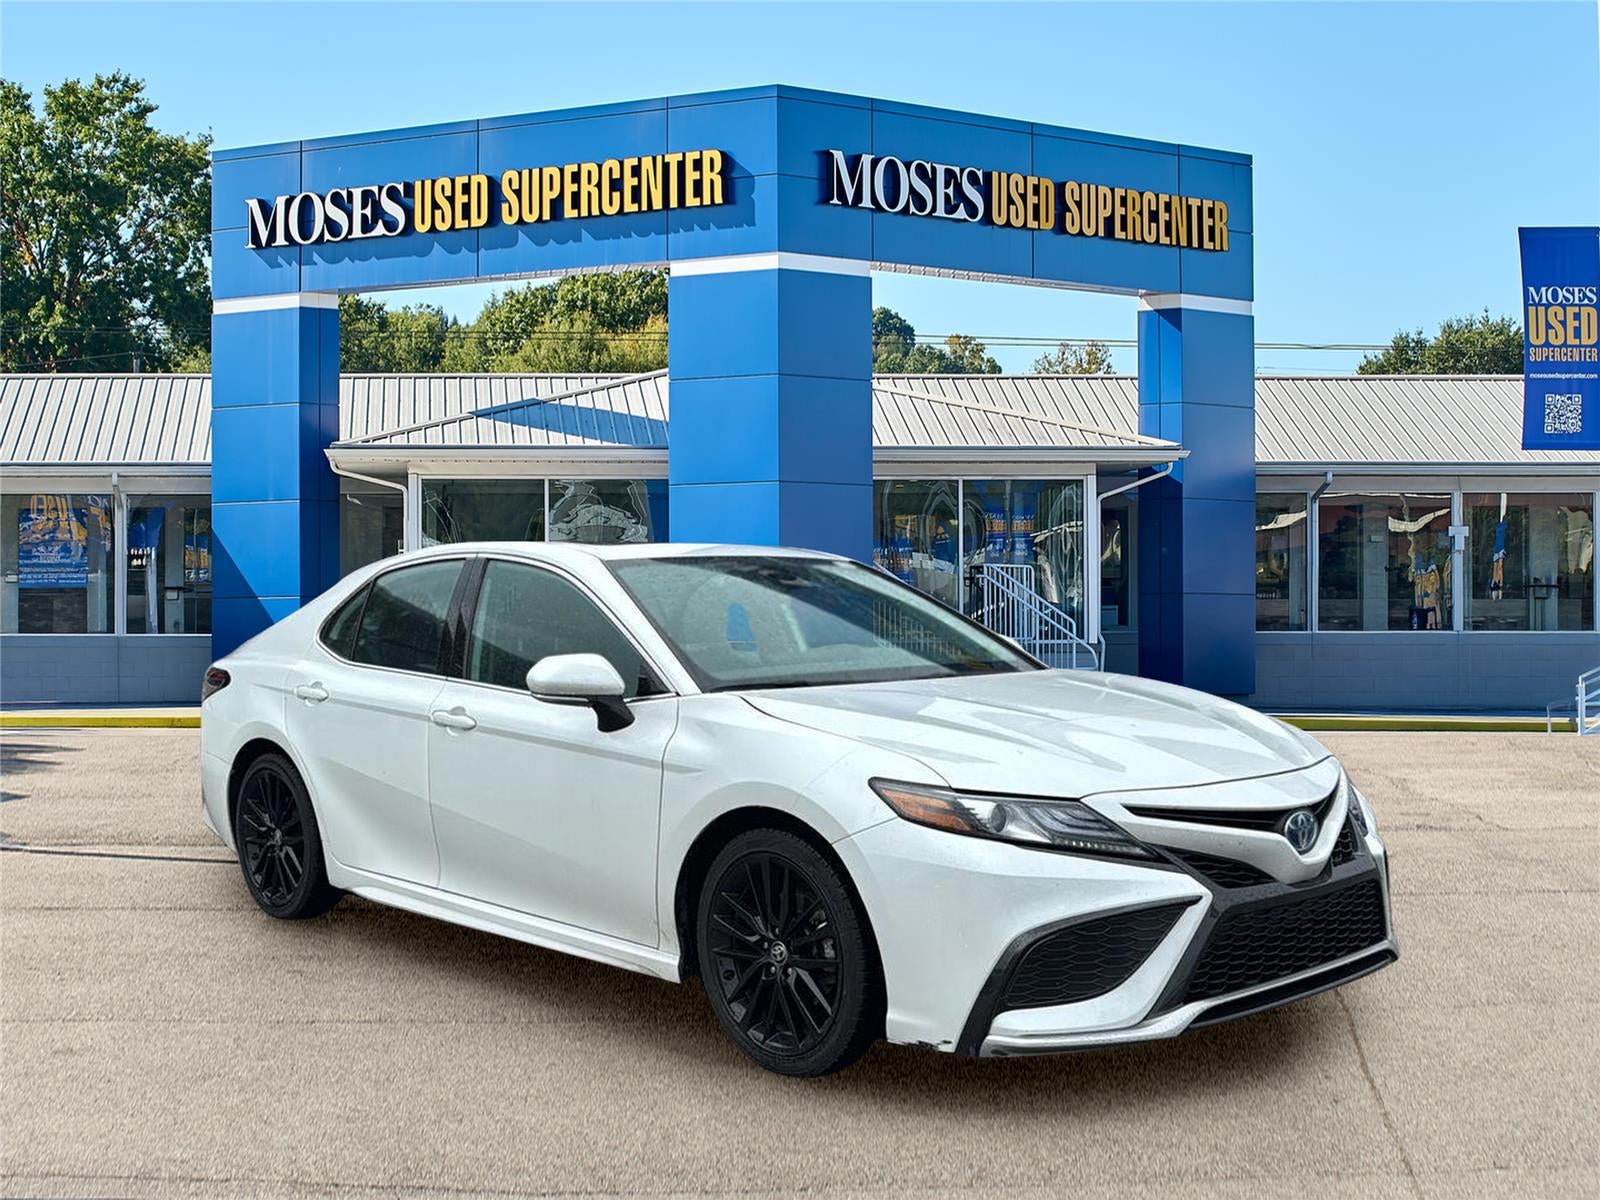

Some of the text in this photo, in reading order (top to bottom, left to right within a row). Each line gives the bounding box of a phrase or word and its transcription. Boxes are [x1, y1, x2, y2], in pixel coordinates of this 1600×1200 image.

[244, 149, 724, 249] MOSES USED SUPERCENTER
[828, 149, 1229, 251] MOSES USED SUPERCENTER
[1527, 286, 1597, 305] MOSES
[1527, 305, 1598, 346] USED
[1529, 347, 1598, 362] SUPERCENTER
